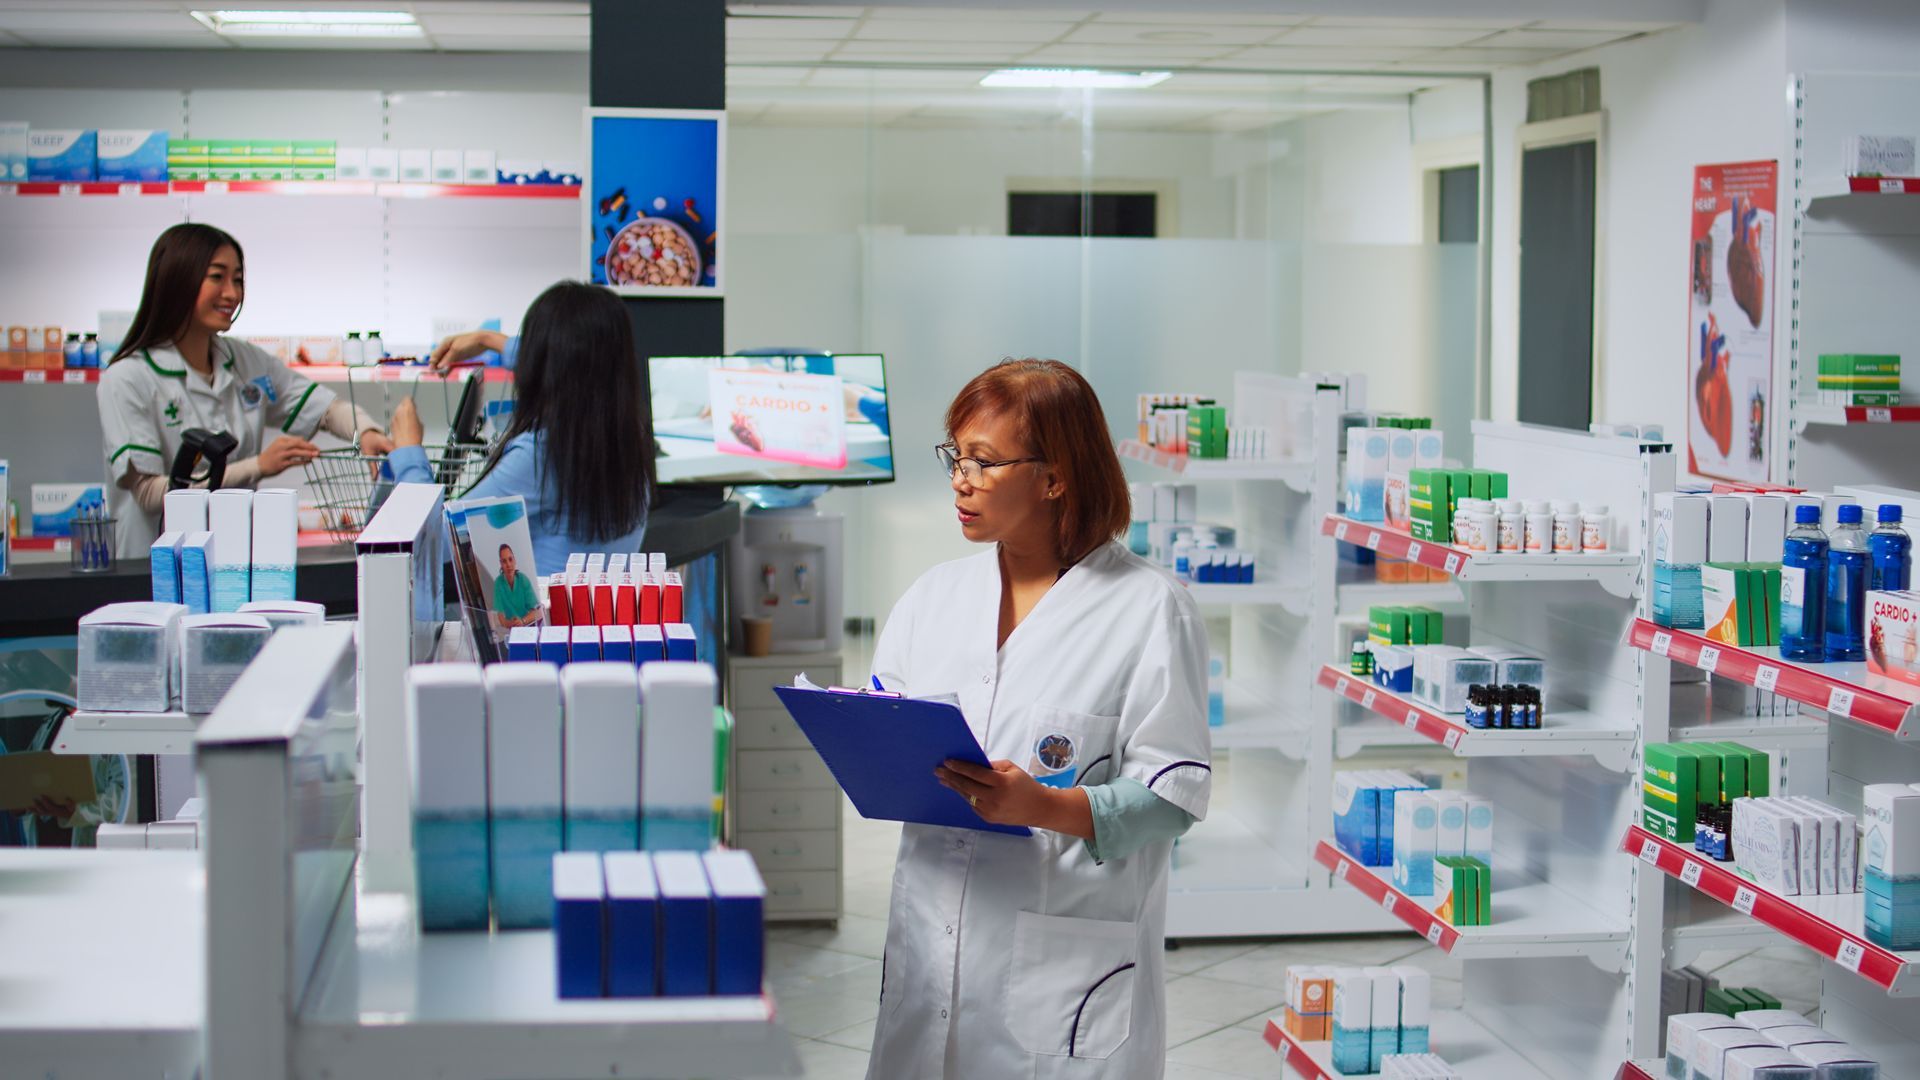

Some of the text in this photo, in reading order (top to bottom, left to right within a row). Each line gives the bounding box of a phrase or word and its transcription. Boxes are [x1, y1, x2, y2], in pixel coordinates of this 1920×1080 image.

[31, 135, 63, 146] SLEEP
[101, 135, 133, 146] SLEEP
[1700, 177, 1712, 191] THE
[1694, 197, 1717, 212] HEART
[735, 394, 812, 412] CARDIO
[36, 492, 67, 502] SLEEP
[1874, 600, 1909, 623] CARDIO
[1667, 824, 1677, 838] 30
[1687, 863, 1697, 875] 7.49
[1845, 945, 1857, 957] 4.99
